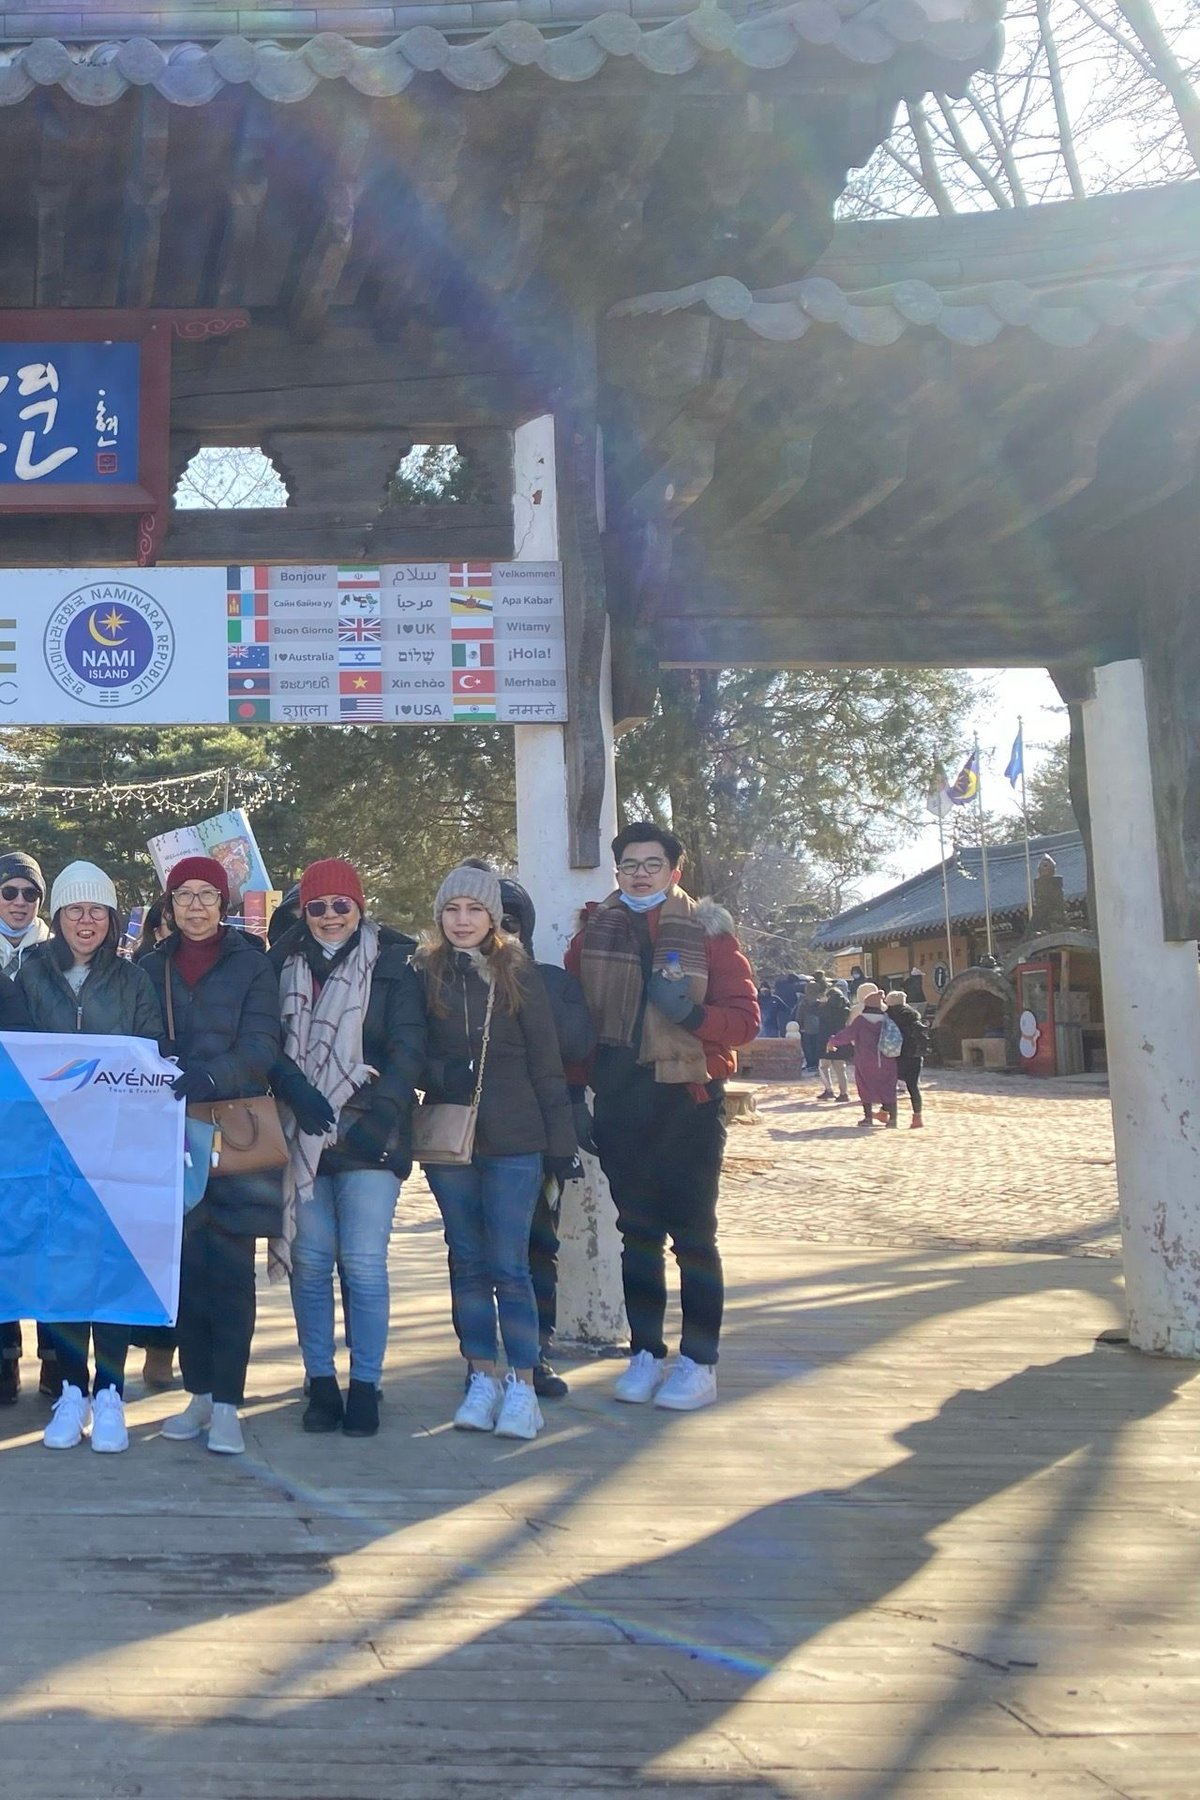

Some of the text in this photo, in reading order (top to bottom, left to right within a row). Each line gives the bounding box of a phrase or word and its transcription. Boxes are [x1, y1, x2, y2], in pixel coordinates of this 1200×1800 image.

[280, 571, 326, 583] Bonjour
[392, 567, 437, 586] سلام
[499, 570, 556, 578] Velkommen
[502, 595, 553, 606] Apa Kabar
[91, 587, 164, 631] NAMINARA
[274, 626, 334, 635] Buon Giorno
[415, 623, 436, 634] UK
[506, 621, 551, 633] Witamy
[82, 649, 135, 667] NAMI
[288, 652, 335, 661] Australia
[508, 648, 551, 661] ¡Hola!
[131, 634, 169, 695] REPUBLIC
[89, 669, 129, 679] ISLAND
[392, 678, 445, 688] Xin chào
[504, 677, 557, 687] Merhaba
[413, 704, 442, 715] USA
[508, 701, 557, 715] नमस्ते
[93, 1067, 176, 1087] AVÉNIR
